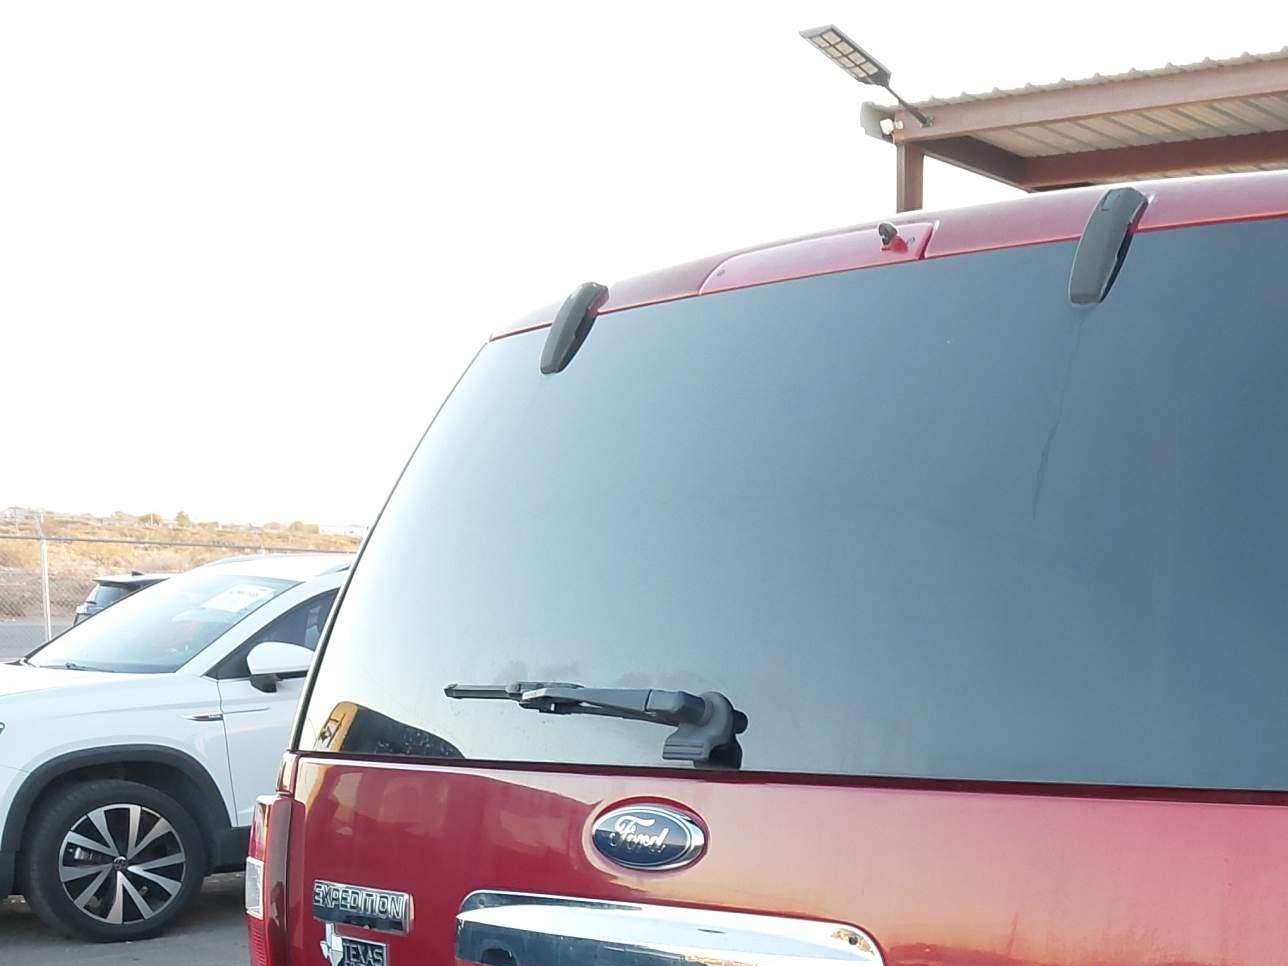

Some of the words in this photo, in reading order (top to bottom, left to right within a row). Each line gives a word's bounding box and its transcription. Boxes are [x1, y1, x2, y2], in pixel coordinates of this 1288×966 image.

[610, 815, 669, 854] Ford
[313, 883, 403, 920] EXPEDITION
[343, 942, 382, 966] TEXAS
